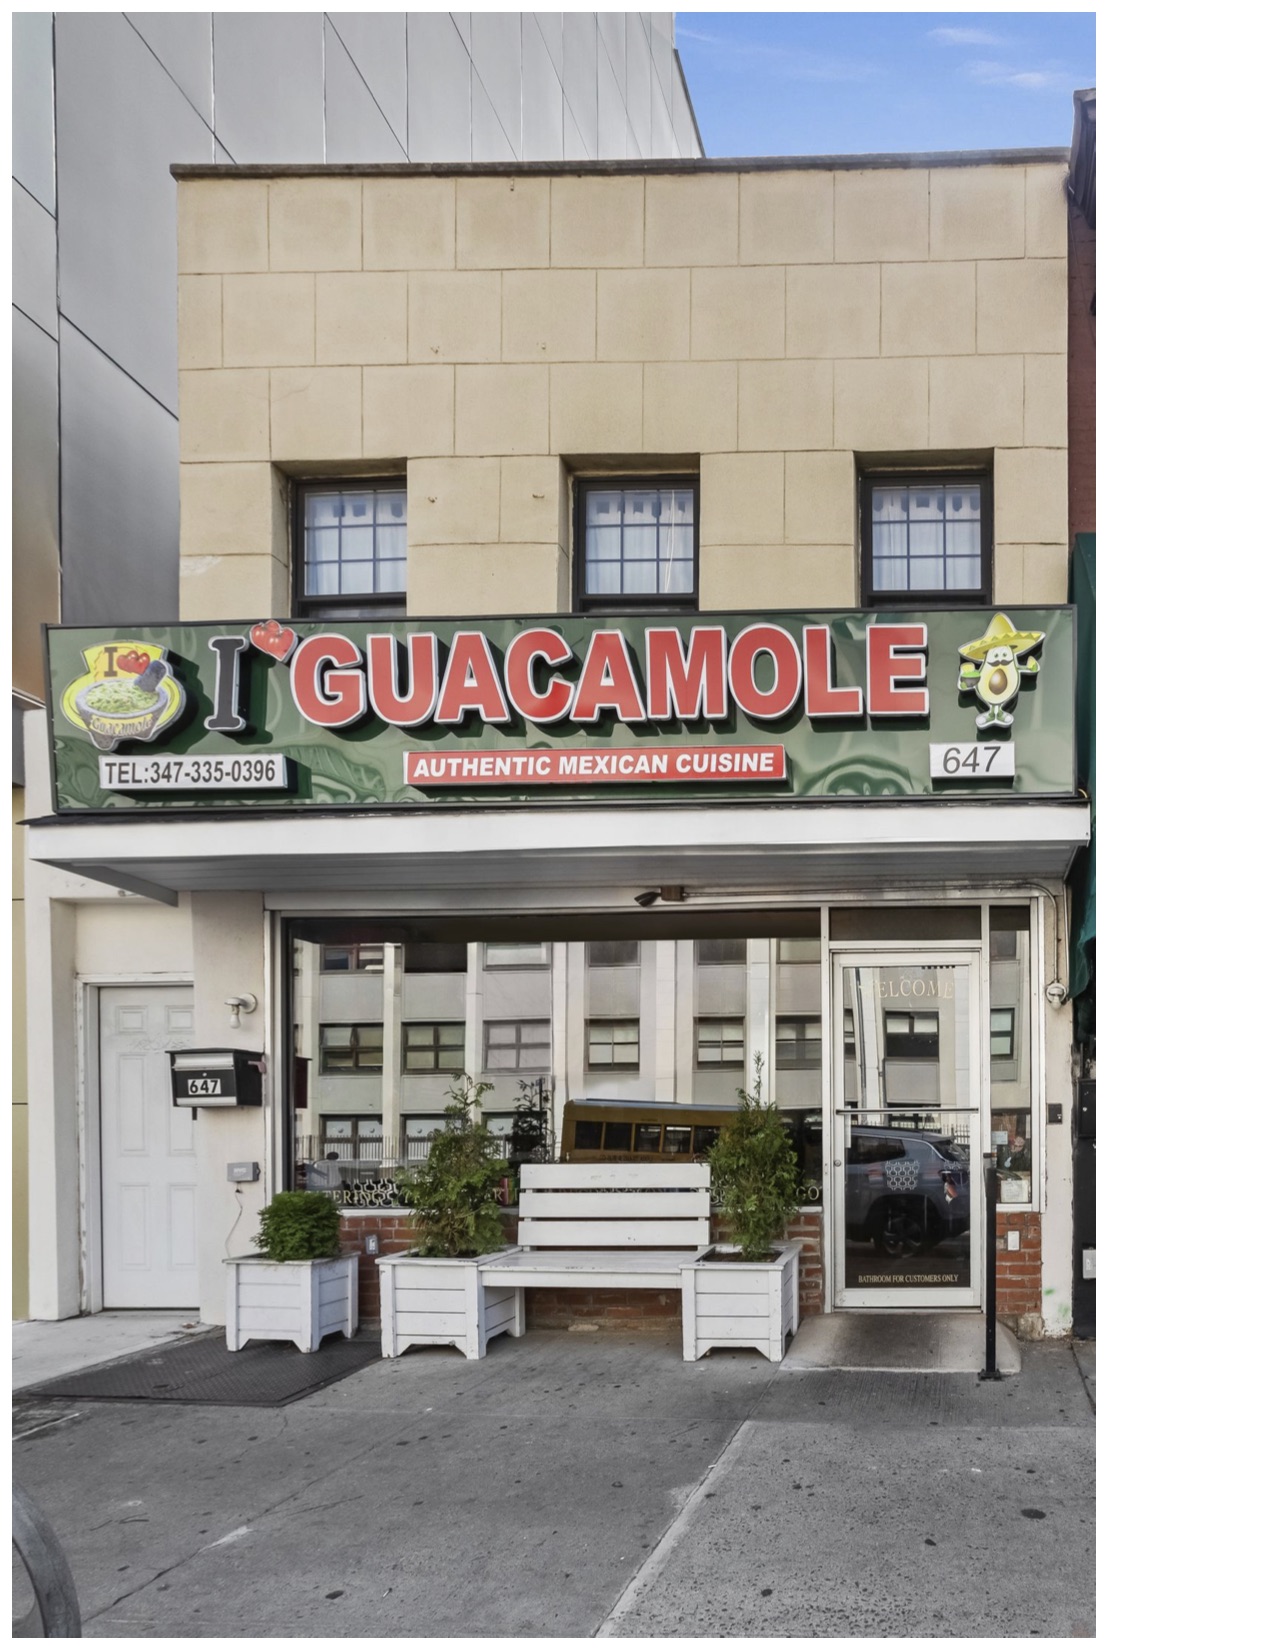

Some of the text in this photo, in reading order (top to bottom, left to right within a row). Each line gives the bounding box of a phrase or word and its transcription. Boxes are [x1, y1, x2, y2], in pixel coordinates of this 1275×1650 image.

[103, 646, 118, 677] I
[204, 622, 930, 731] I GUACAMOLE
[105, 760, 276, 784] TEL:347-335-0396
[413, 753, 774, 777] AUTHENTIC MEXICAN CUISINE
[942, 746, 1002, 774] 647
[852, 979, 954, 999] ELCOME
[189, 1079, 219, 1094] 647
[858, 1273, 959, 1284] BATHROOM FOR CUSTOMERS ONLY
